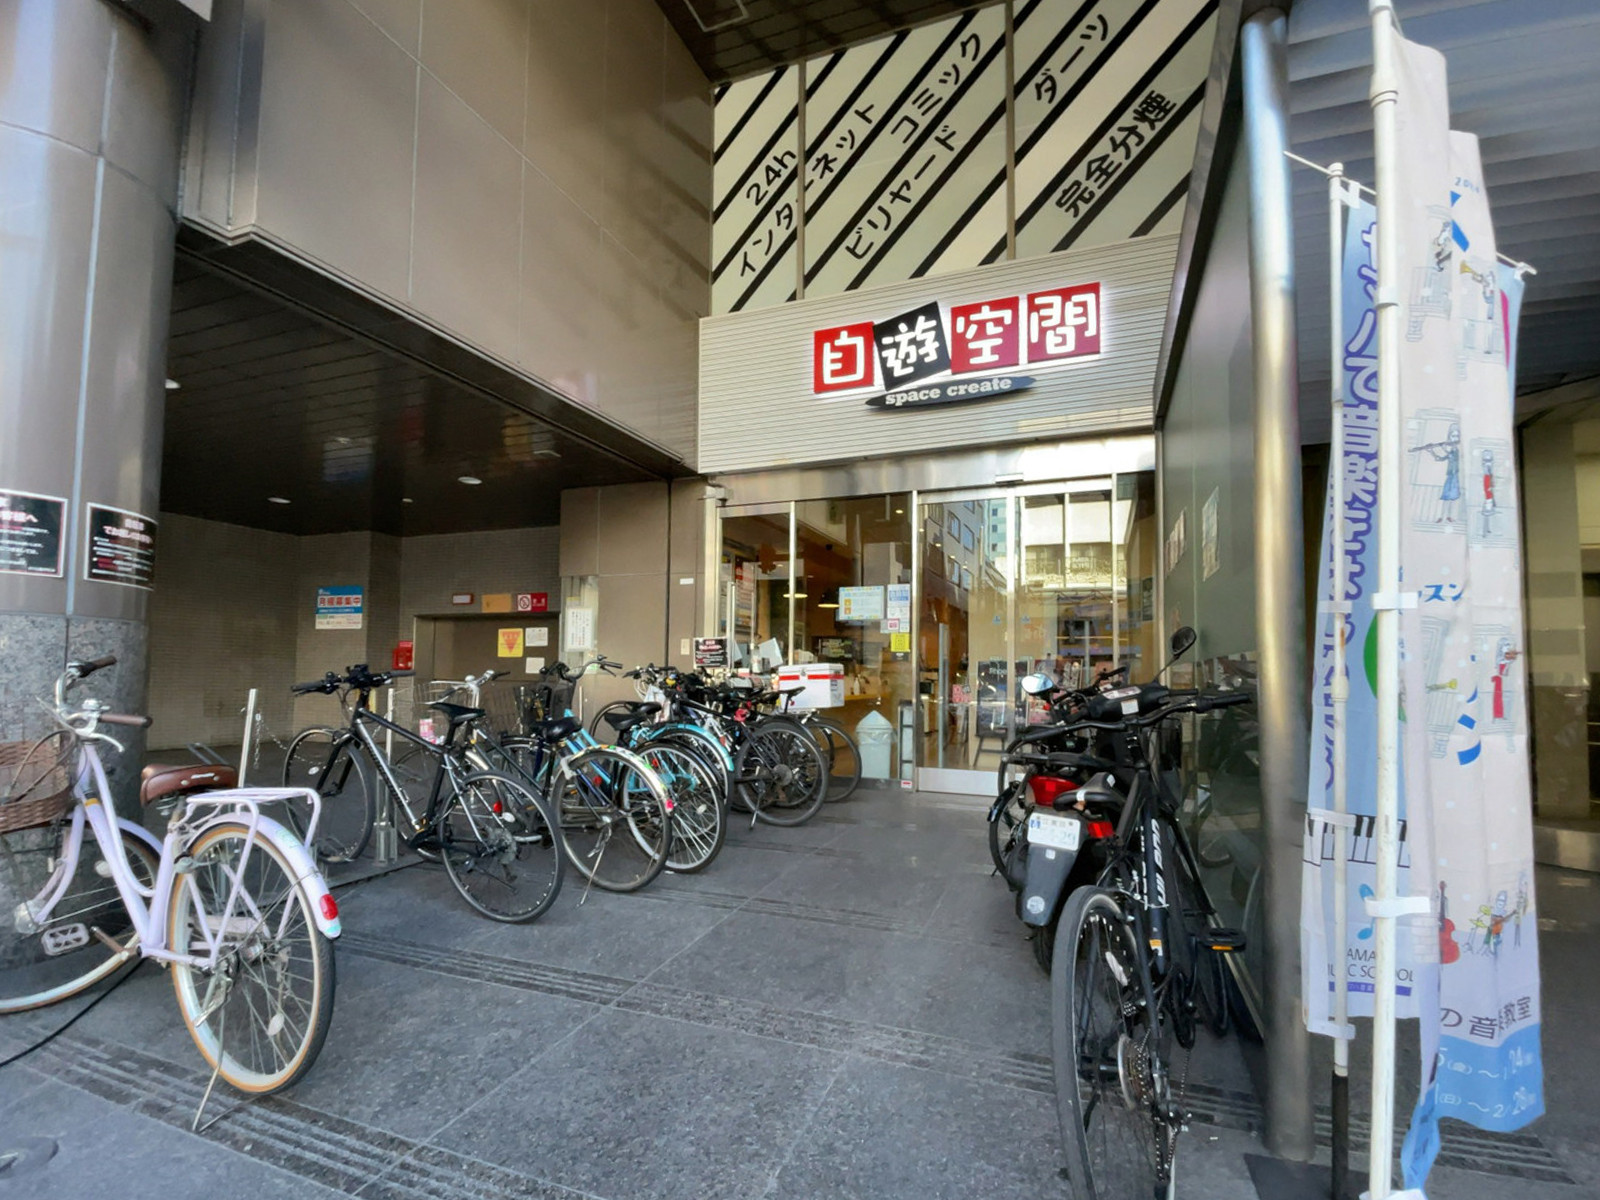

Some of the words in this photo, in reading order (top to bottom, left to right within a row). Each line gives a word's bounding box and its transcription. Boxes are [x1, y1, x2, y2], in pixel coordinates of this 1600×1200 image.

[890, 32, 983, 144] コミック
[1034, 12, 1109, 104] ダーツ
[745, 148, 798, 206] 24h
[844, 123, 958, 261] ビリヤード
[1054, 89, 1177, 218] 完全分煙
[821, 292, 1097, 385] 自遊空間
[885, 385, 941, 408] space
[946, 376, 1013, 398] create
[1360, 964, 1414, 982] SCOL
